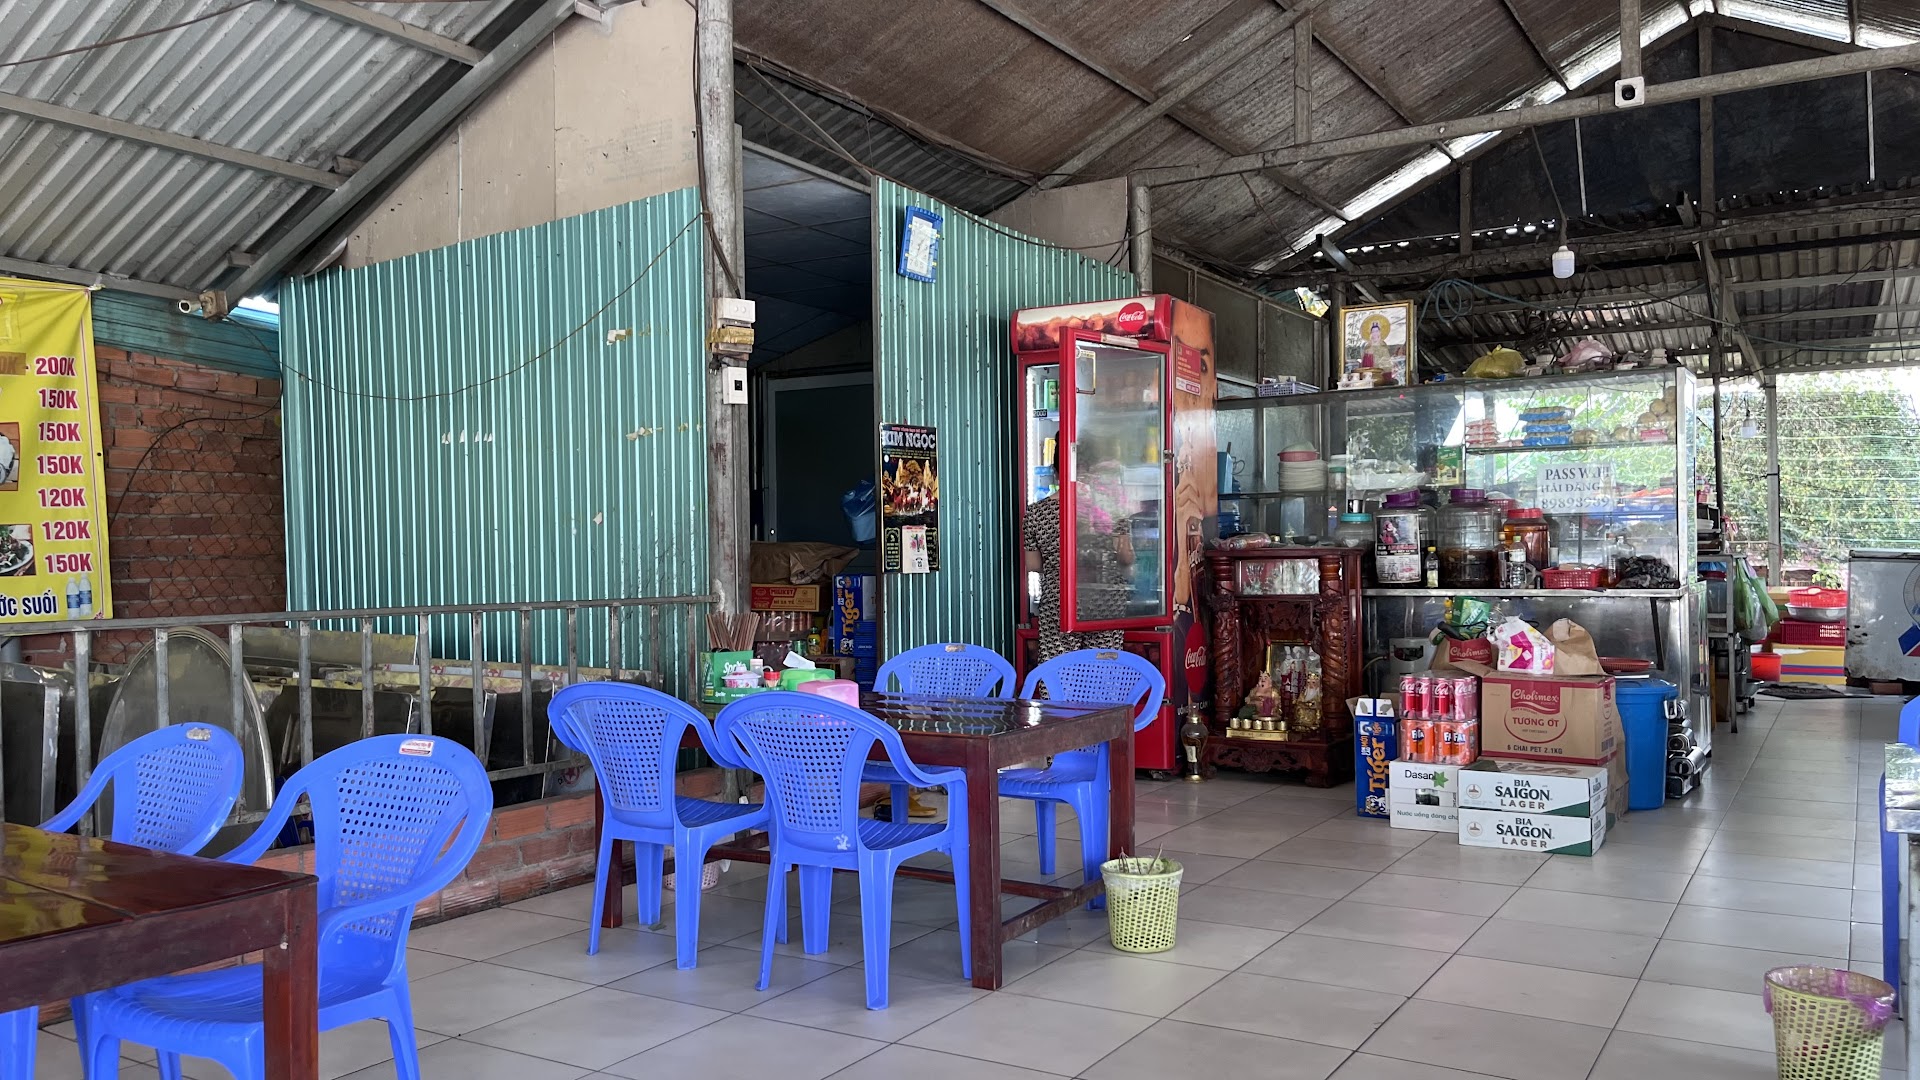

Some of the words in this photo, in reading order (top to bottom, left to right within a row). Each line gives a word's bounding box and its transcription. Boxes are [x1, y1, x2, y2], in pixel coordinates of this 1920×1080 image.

[35, 356, 76, 376] 200K
[38, 388, 78, 409] 150K
[38, 422, 81, 442] 150K
[882, 430, 904, 447] KIM
[905, 432, 936, 451] NGỌC
[36, 455, 84, 475] 150K
[1545, 467, 1576, 481] PASS
[38, 488, 86, 508] 120K
[42, 521, 91, 541] 120K
[45, 553, 93, 574] 150K
[22, 589, 58, 616] SUỐI
[1511, 688, 1558, 703] Cholimex
[1513, 744, 1528, 752] CHAI
[1529, 745, 1542, 753] PET
[1366, 737, 1390, 793] Tiger
[1405, 769, 1435, 780] Dasan
[1514, 779, 1531, 788] BIA
[1495, 785, 1550, 801] SAIGON
[1500, 798, 1545, 810] LAGER
[1515, 817, 1533, 826] BIA
[1496, 823, 1552, 840] SAIGON
[1501, 837, 1548, 849] LAGER
